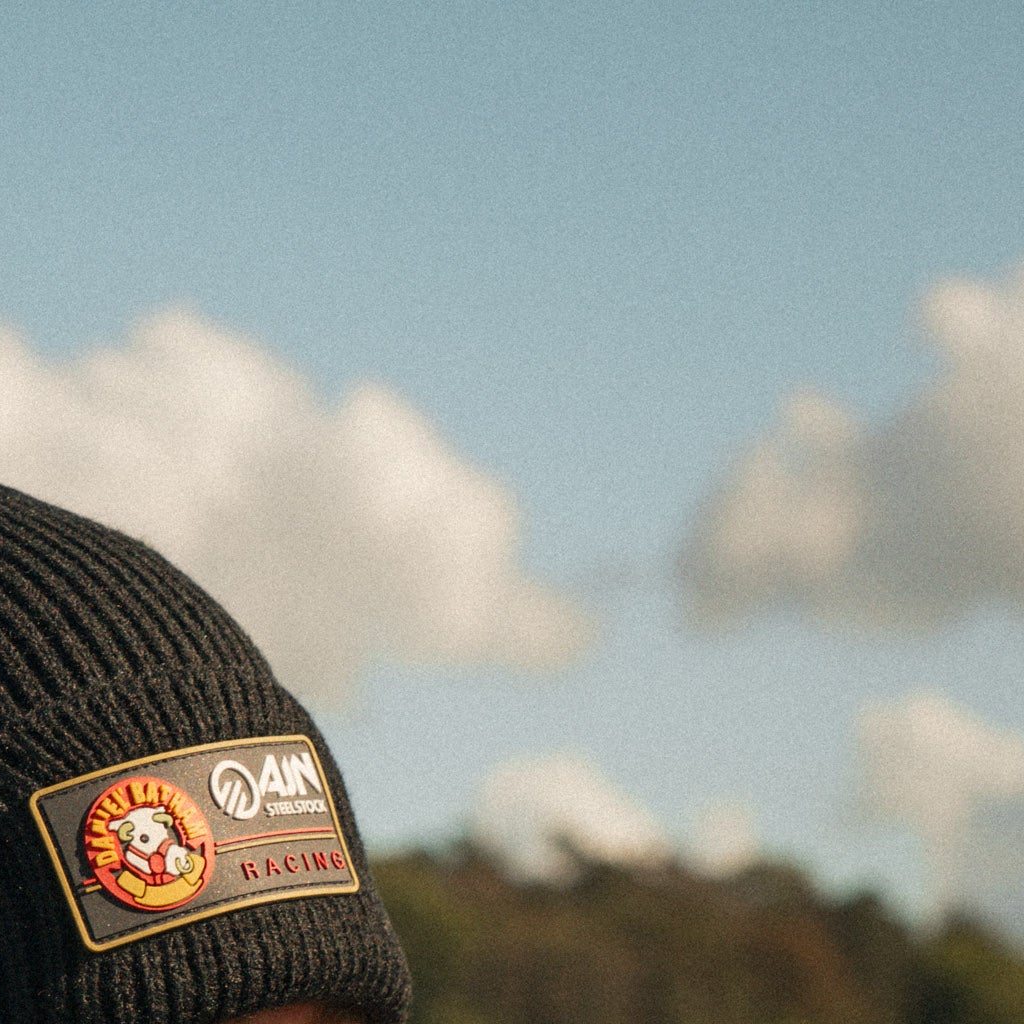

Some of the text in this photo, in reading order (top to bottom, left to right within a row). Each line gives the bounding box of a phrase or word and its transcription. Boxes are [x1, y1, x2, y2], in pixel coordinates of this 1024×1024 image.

[265, 799, 327, 817] STEELSTOCK
[91, 787, 131, 868] DANIEL
[241, 850, 345, 880] RACING
